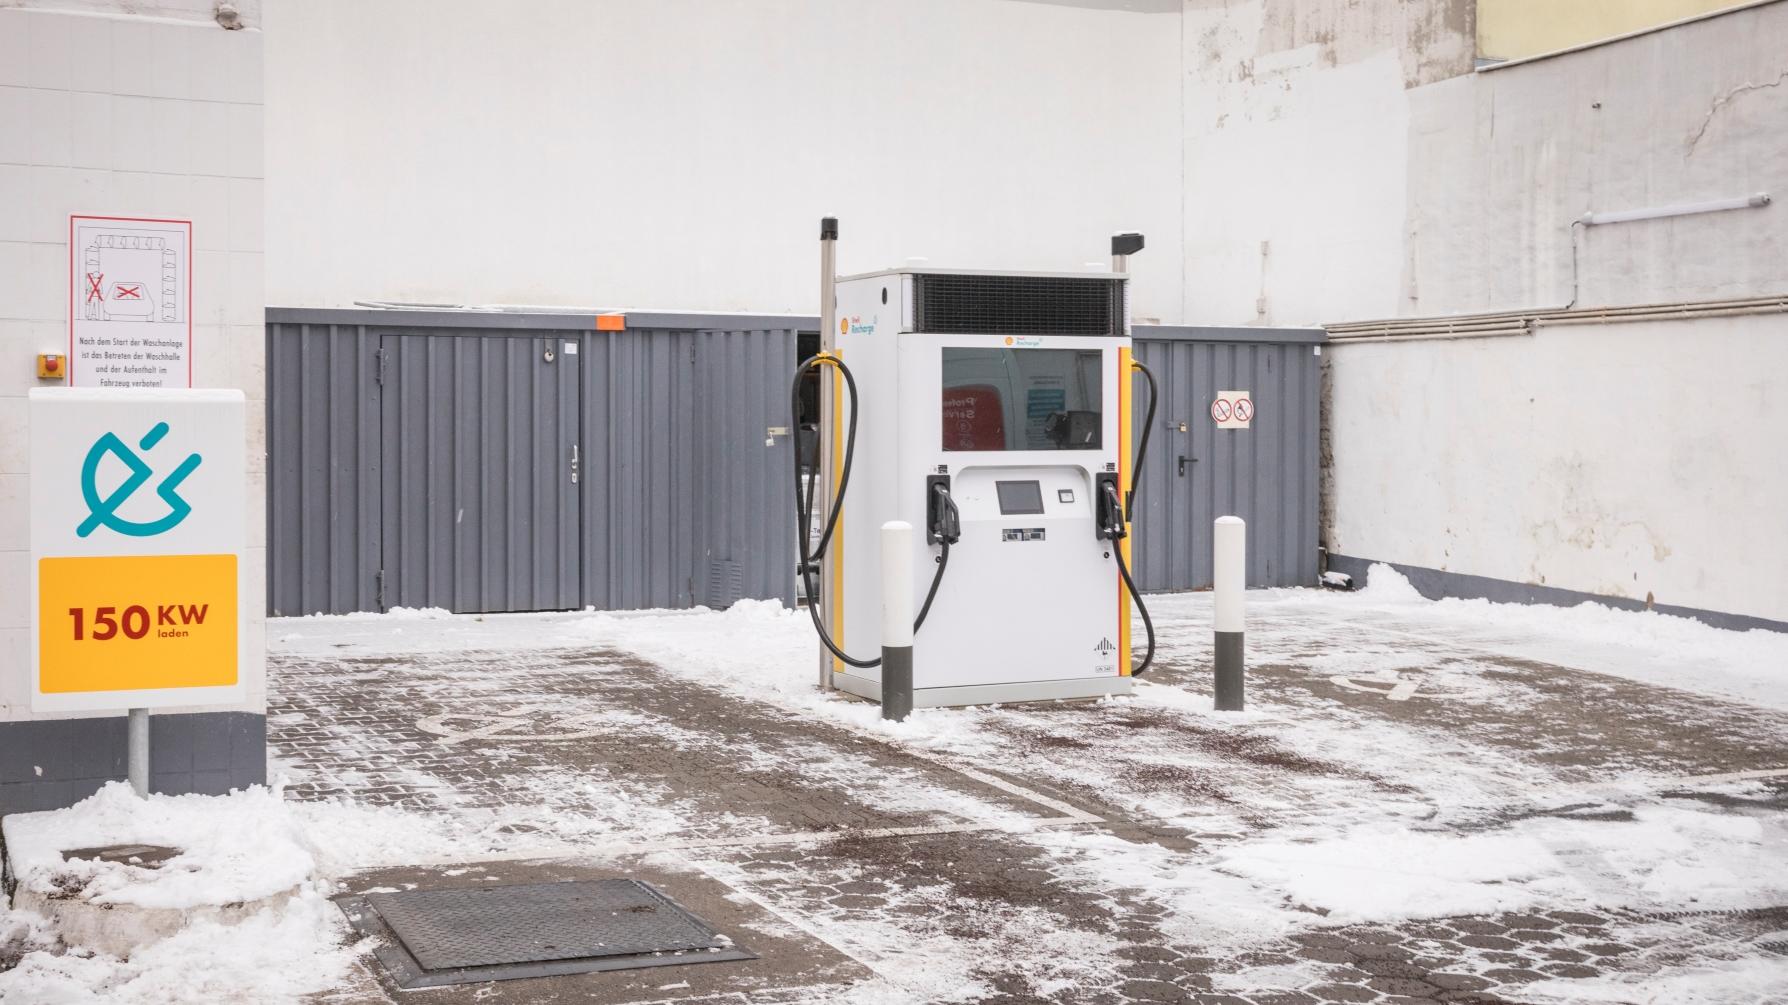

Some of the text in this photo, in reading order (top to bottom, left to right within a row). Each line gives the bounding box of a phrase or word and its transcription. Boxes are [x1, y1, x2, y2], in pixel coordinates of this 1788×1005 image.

[79, 337, 183, 349] Nach dem Start der Waschanlage
[81, 351, 180, 361] ist das Betreten der Waschhalle
[95, 365, 167, 374] und der Aufenthalt im
[100, 379, 163, 388] Fahrzeug verboten!
[69, 603, 209, 641] 150 KW
[157, 629, 189, 638] laden
